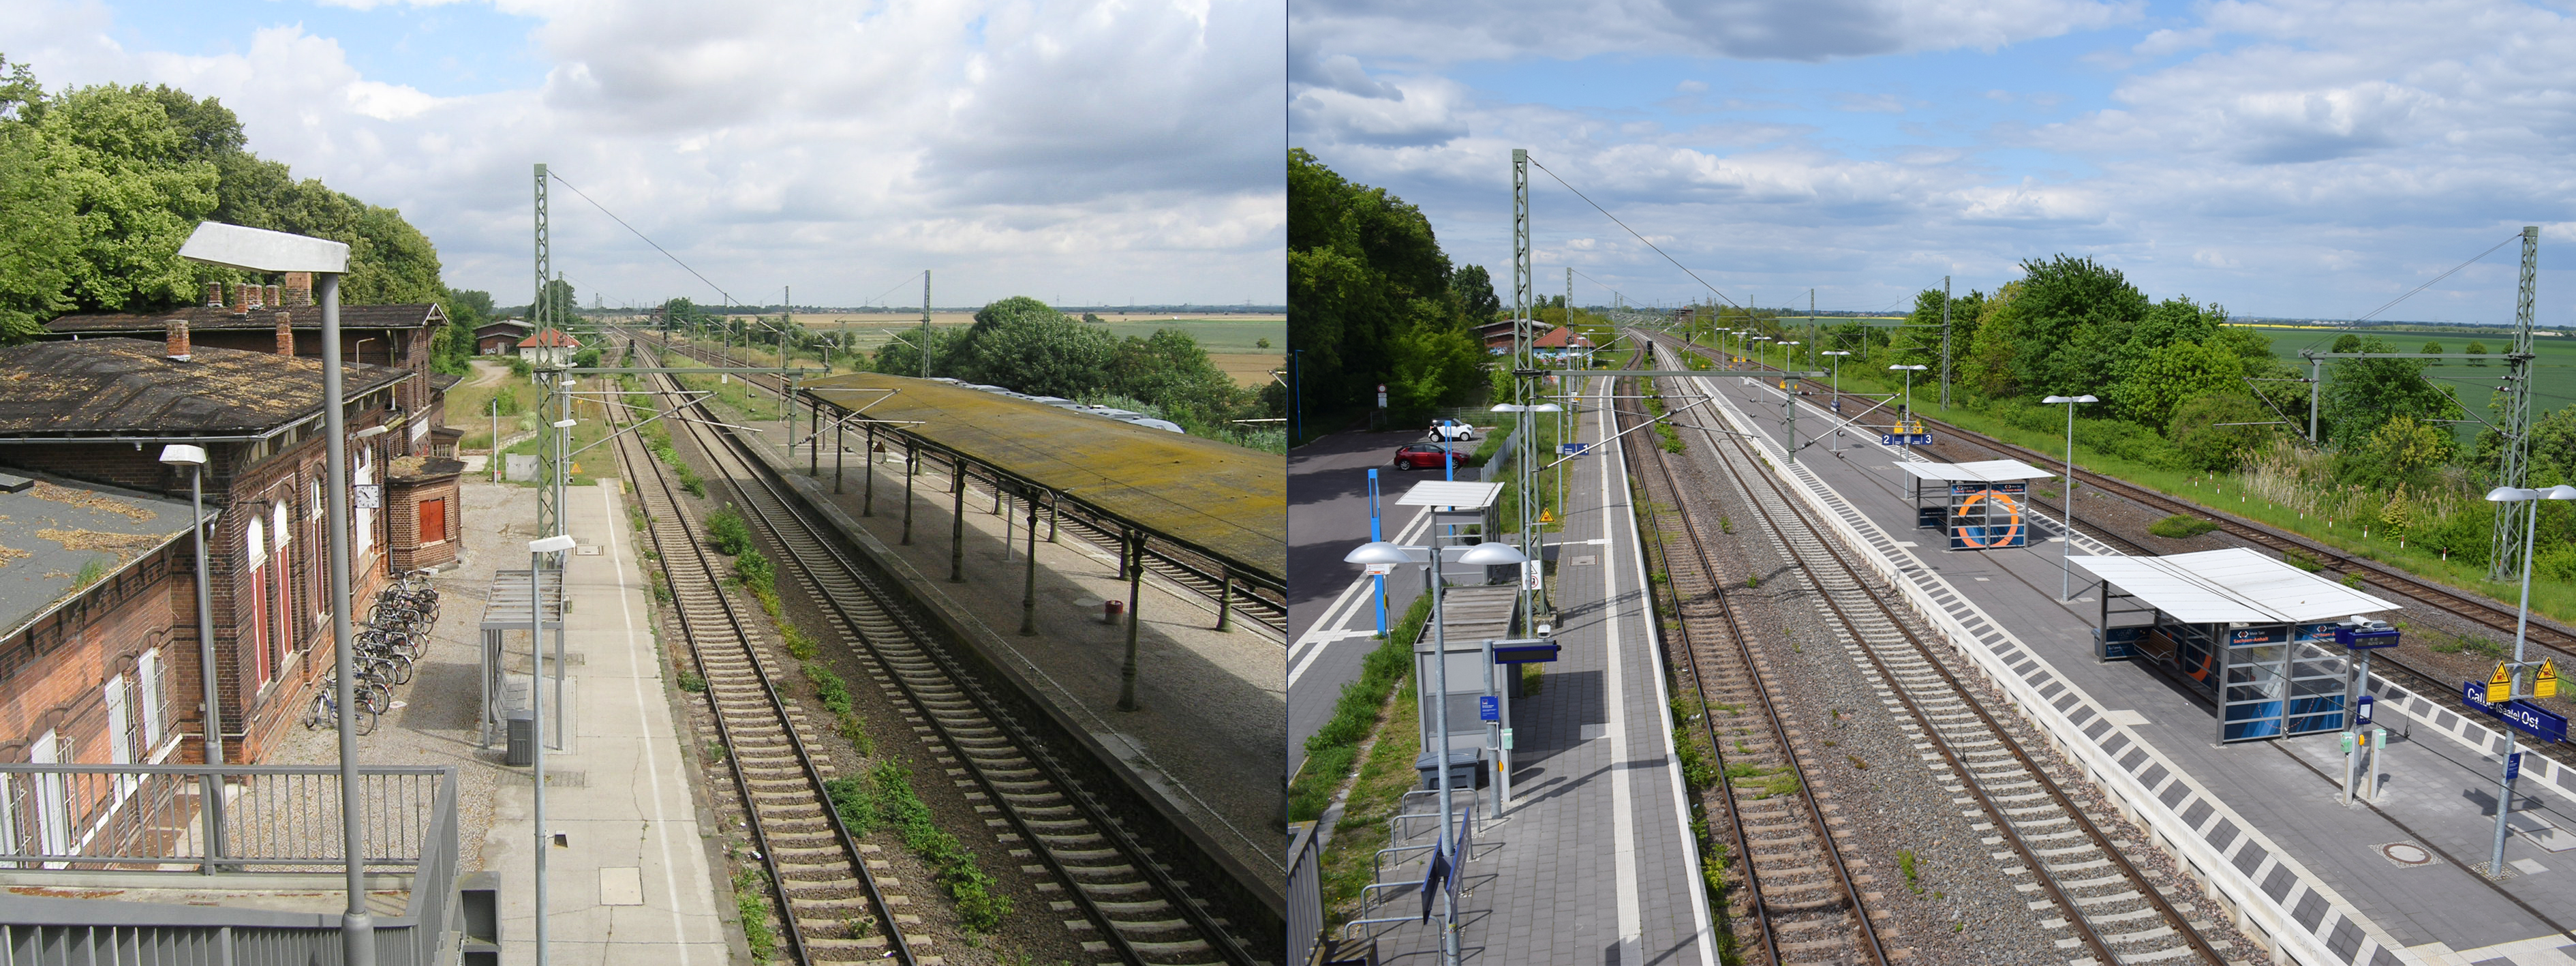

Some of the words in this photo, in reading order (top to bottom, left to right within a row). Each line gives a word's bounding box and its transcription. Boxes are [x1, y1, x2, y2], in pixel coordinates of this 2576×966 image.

[1884, 435, 1889, 444] 2
[1925, 434, 1931, 444] 3
[2496, 702, 2520, 721] (Saale)
[2521, 711, 2539, 729] Ost
